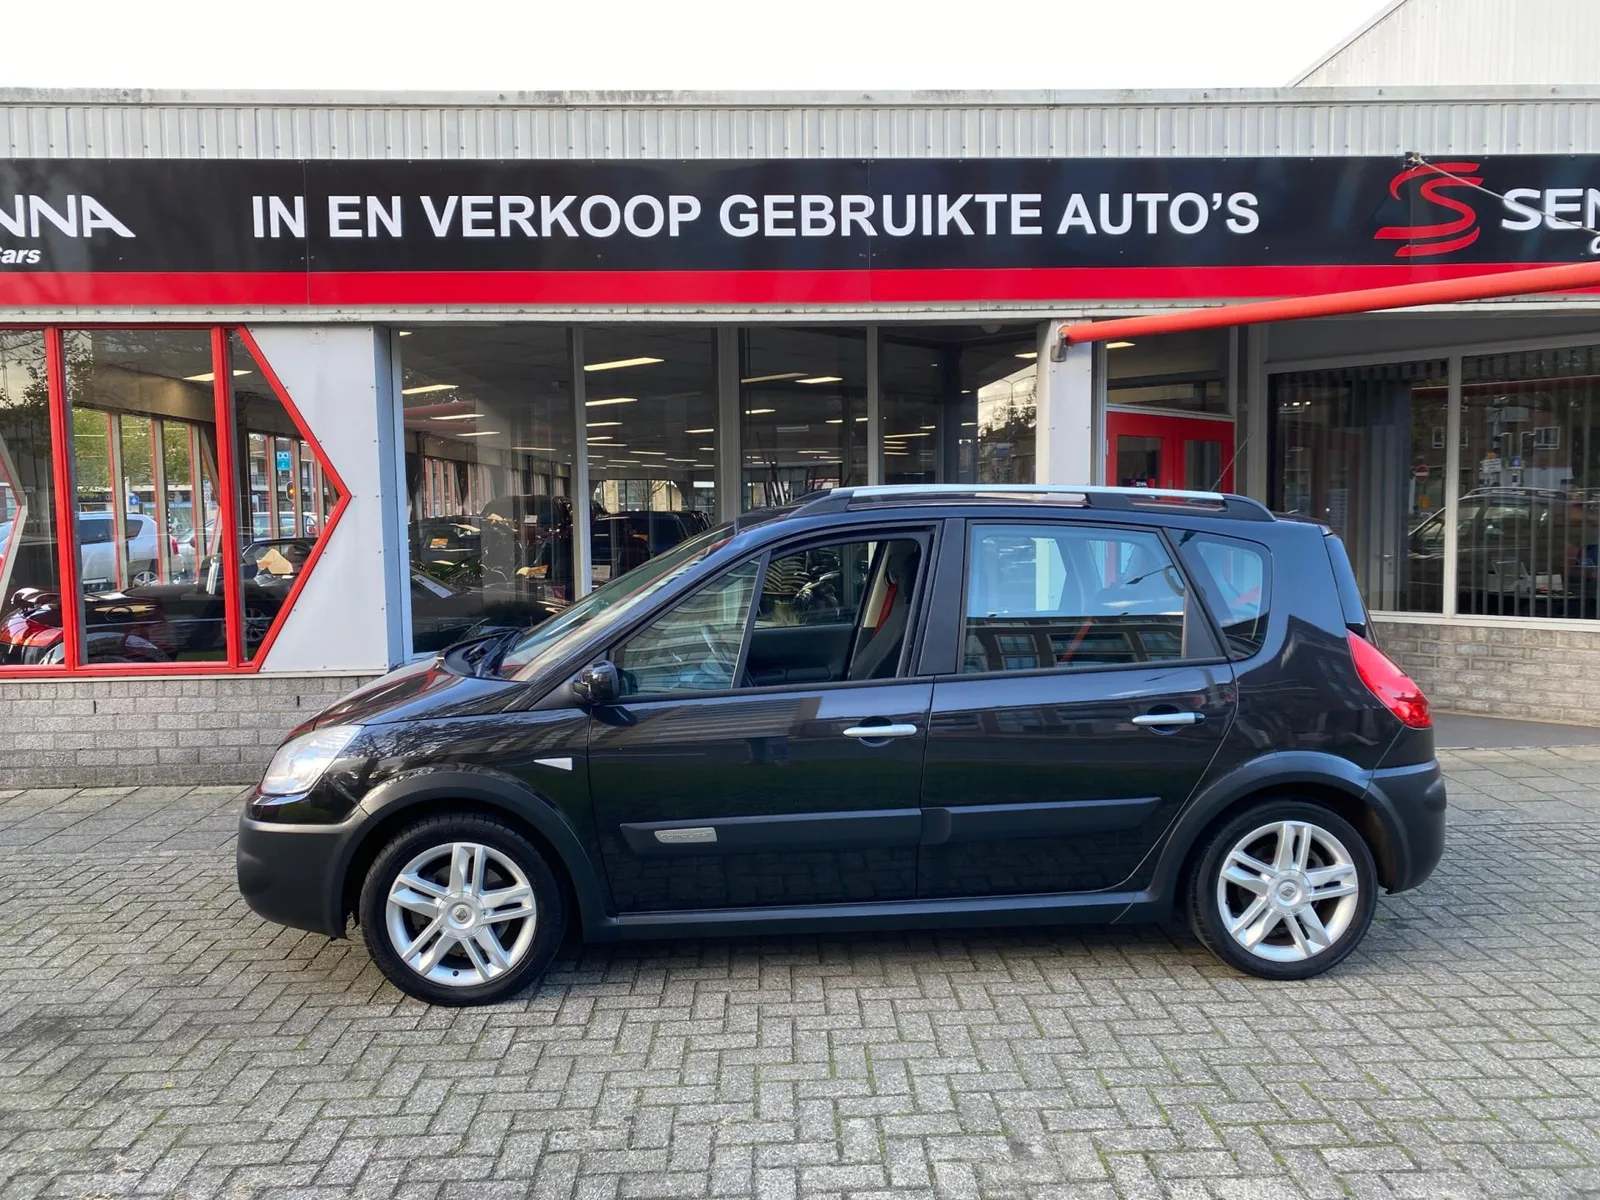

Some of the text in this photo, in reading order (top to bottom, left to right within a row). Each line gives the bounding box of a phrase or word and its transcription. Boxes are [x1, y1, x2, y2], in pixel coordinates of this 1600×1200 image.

[252, 191, 1260, 238] IN EN VERKOOP GEBRUIKTE AUTO’S
[1501, 188, 1600, 231] SE
[0, 246, 41, 264] ars
